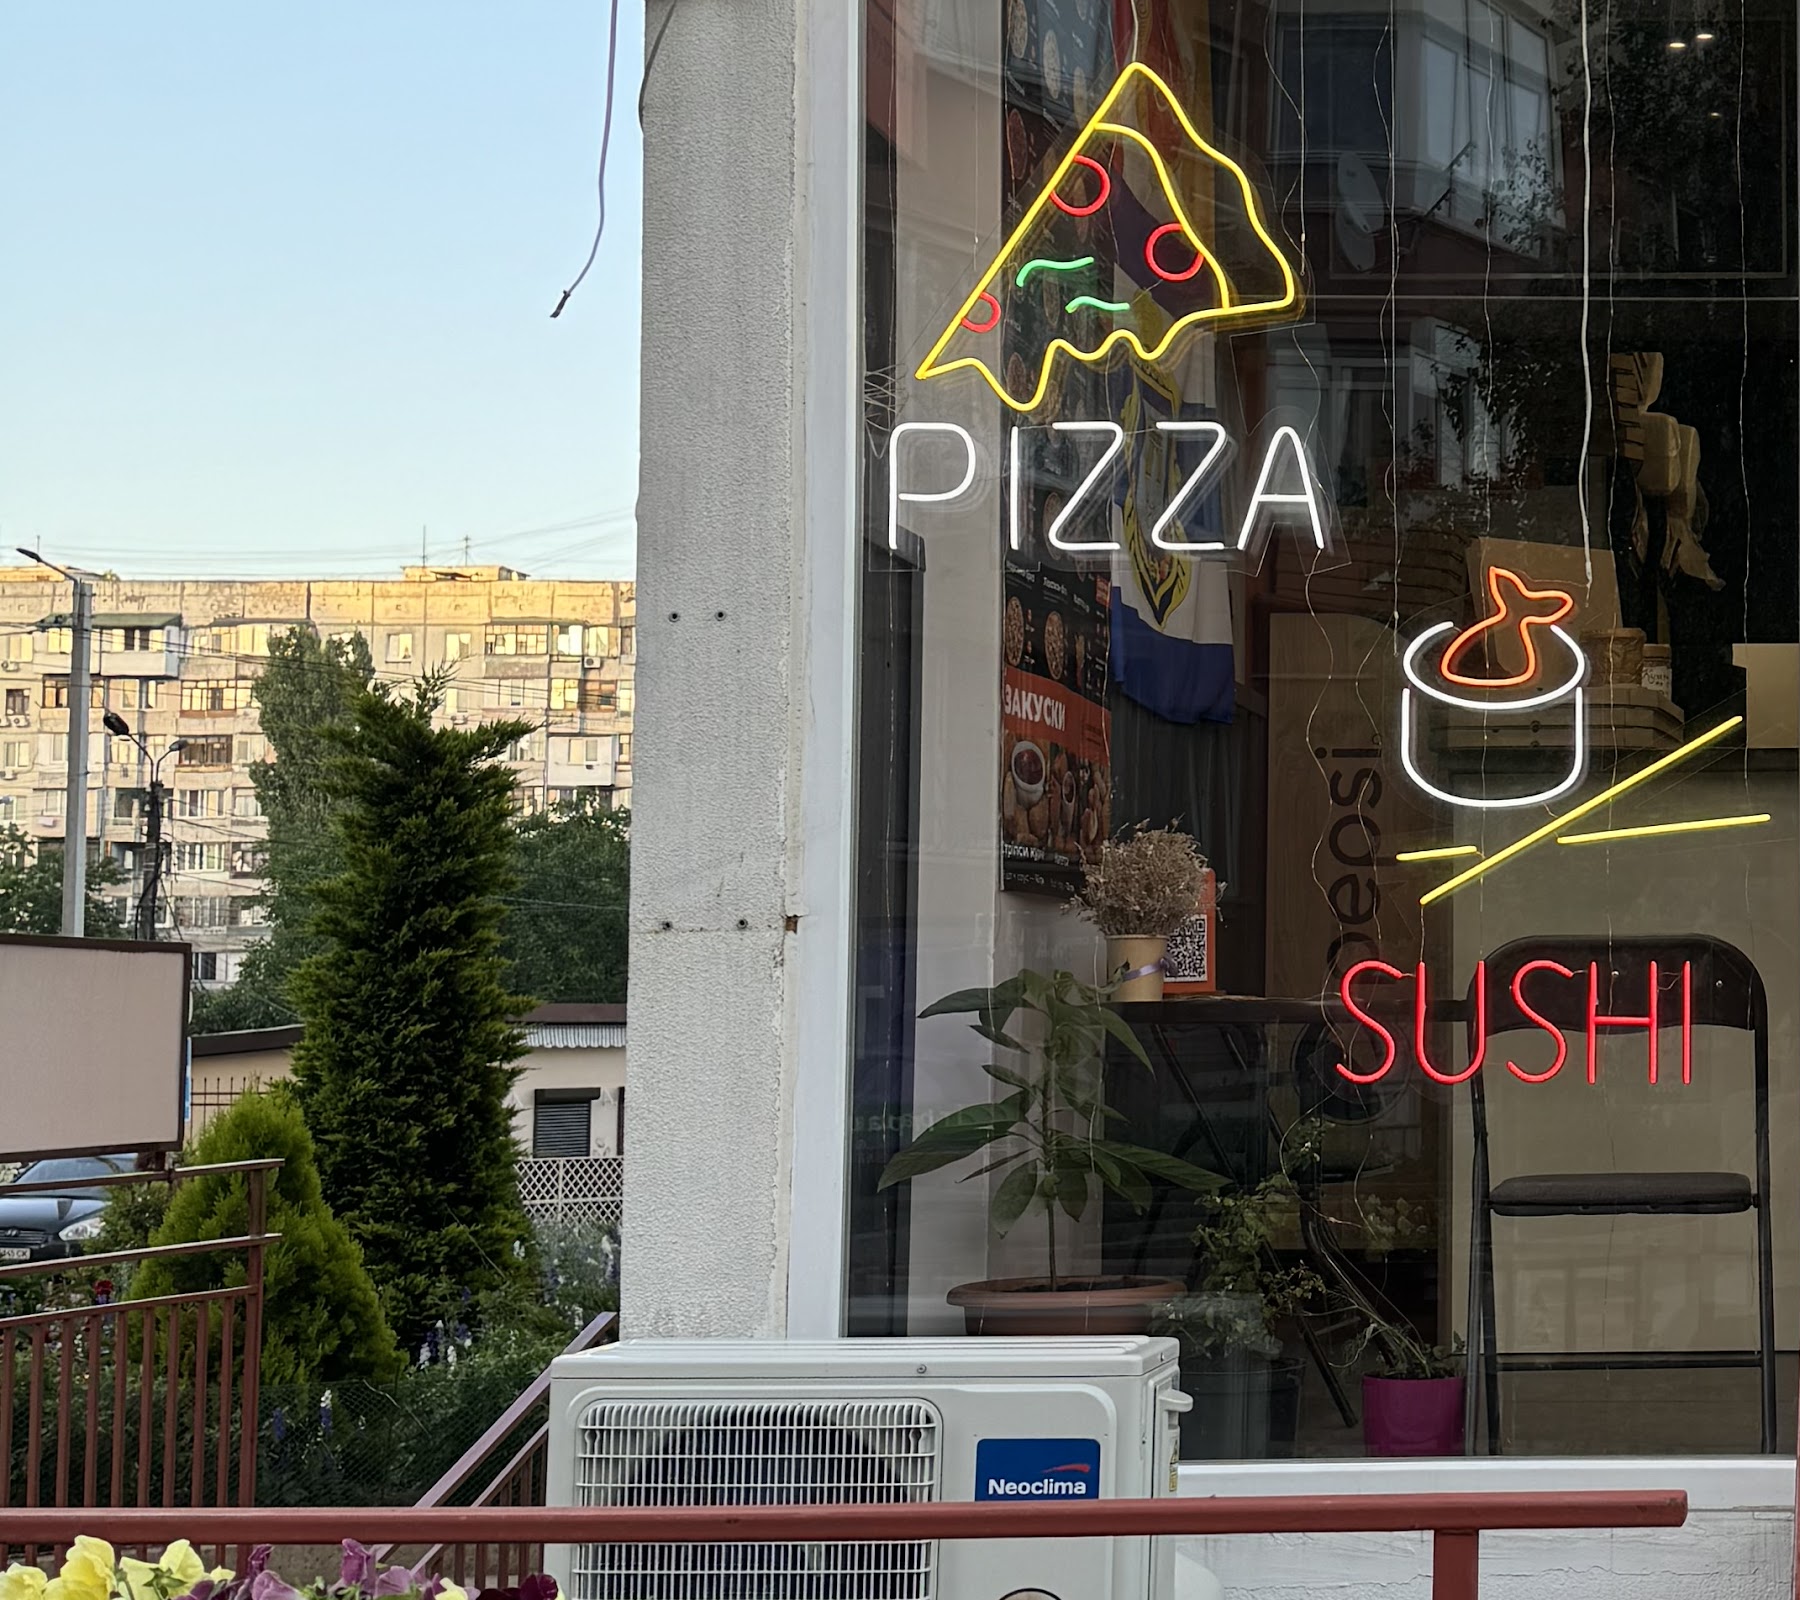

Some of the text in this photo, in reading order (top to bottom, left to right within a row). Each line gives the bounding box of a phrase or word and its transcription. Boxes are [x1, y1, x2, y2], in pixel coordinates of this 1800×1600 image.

[888, 421, 1326, 552] PIZZA
[1004, 683, 1066, 733] ЗАКУСКИ
[1336, 959, 1691, 1085] SUSHI
[987, 1478, 1087, 1496] Neoclima
